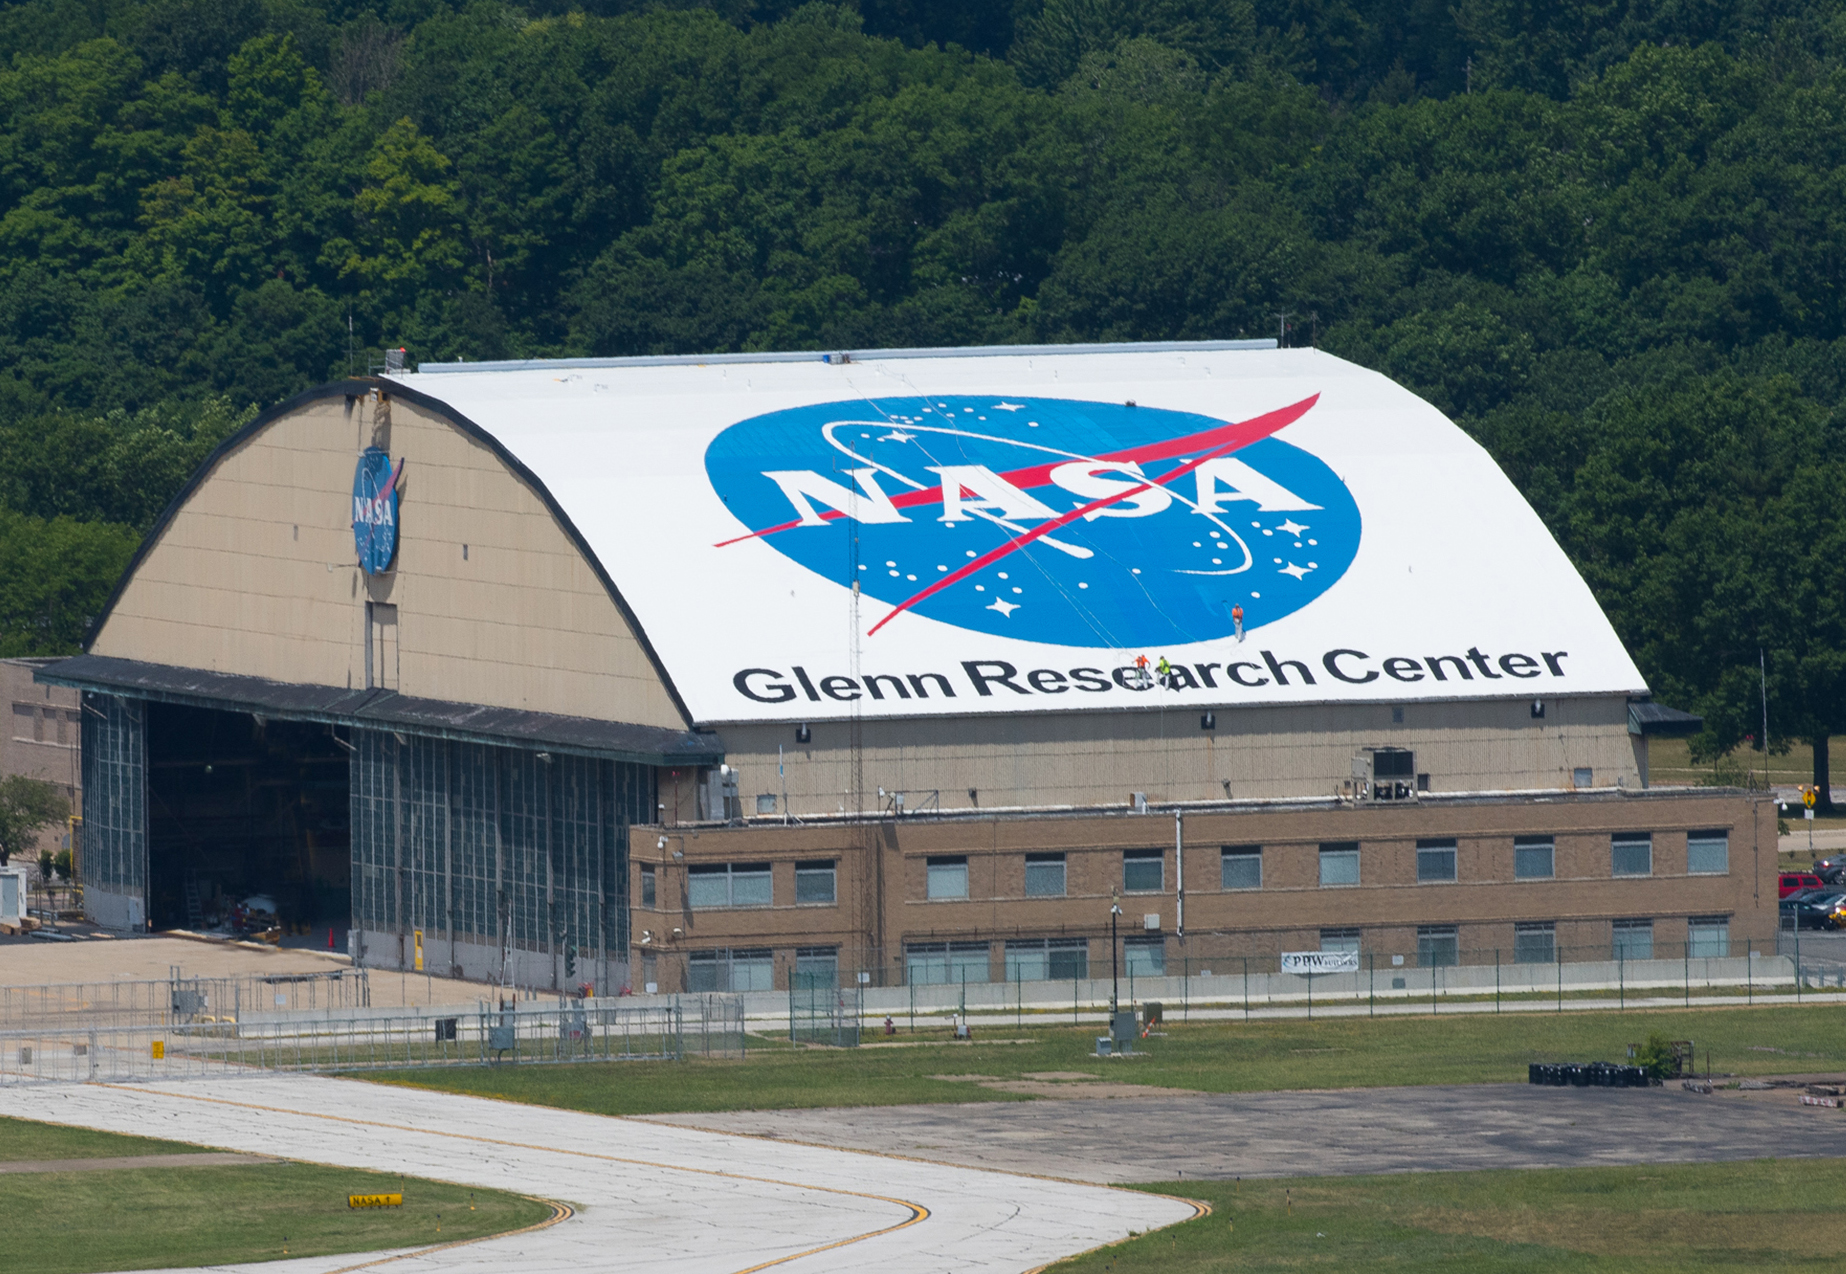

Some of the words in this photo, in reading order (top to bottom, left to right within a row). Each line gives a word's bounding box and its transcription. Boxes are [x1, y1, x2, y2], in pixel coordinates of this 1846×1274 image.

[760, 457, 1324, 526] NASA
[356, 496, 393, 525] NASA
[732, 661, 956, 703] Glenn
[960, 650, 1313, 697] Research
[1322, 647, 1568, 684] Center
[1293, 955, 1324, 967] PPW
[353, 1196, 381, 1206] NASA
